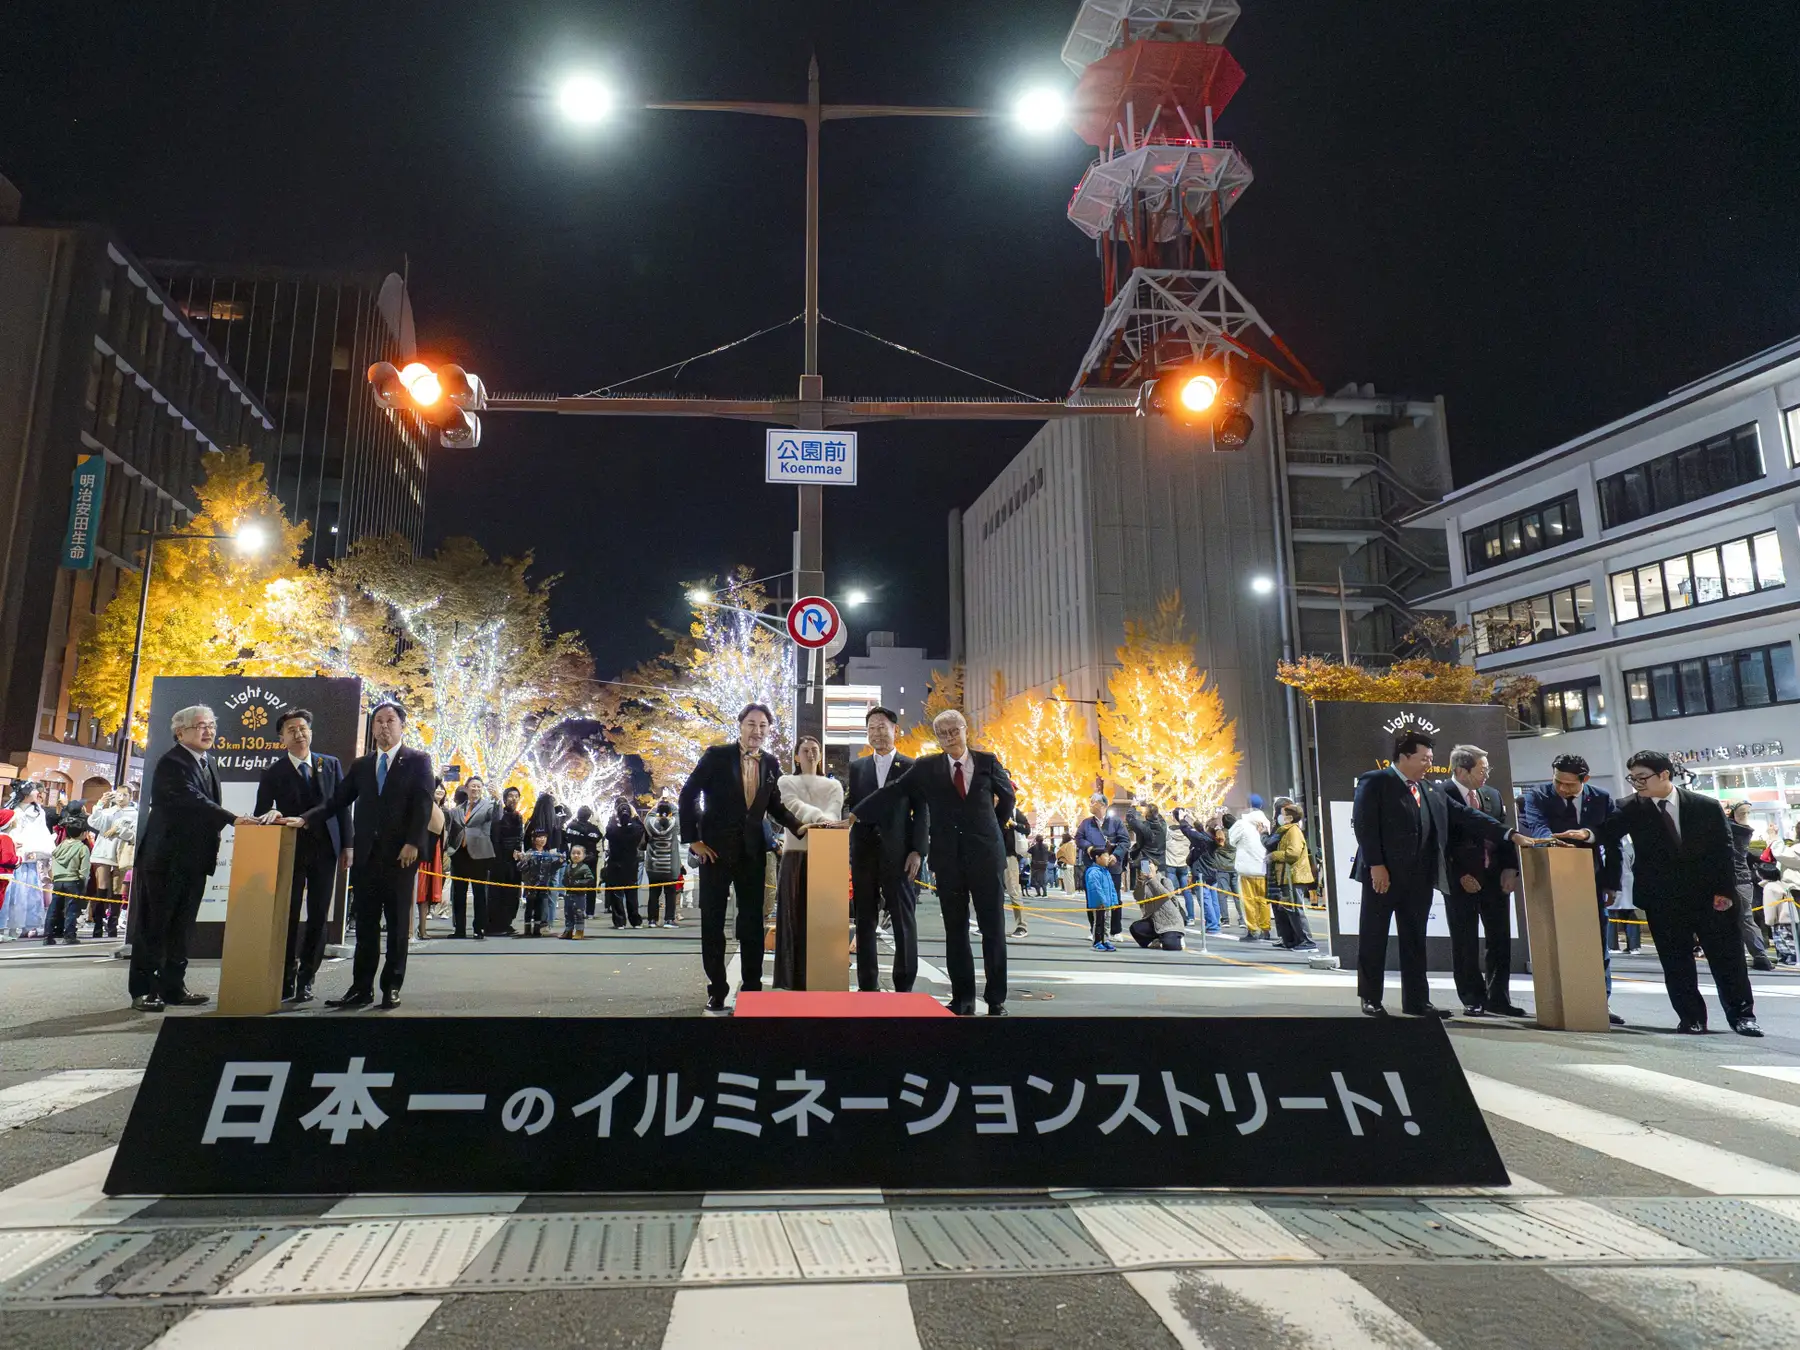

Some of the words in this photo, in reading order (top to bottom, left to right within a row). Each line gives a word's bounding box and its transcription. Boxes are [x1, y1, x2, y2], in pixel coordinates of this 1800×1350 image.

[777, 440, 846, 462] 公園前
[780, 461, 843, 475] Koenmae
[69, 474, 96, 559] 明治安田生命
[224, 685, 261, 710] Light
[263, 691, 288, 710] up!
[1382, 711, 1415, 735] Light
[1417, 716, 1441, 735] up!
[234, 755, 268, 771] Light
[201, 1056, 1421, 1146] 日本一のイルミネーションストリート!
